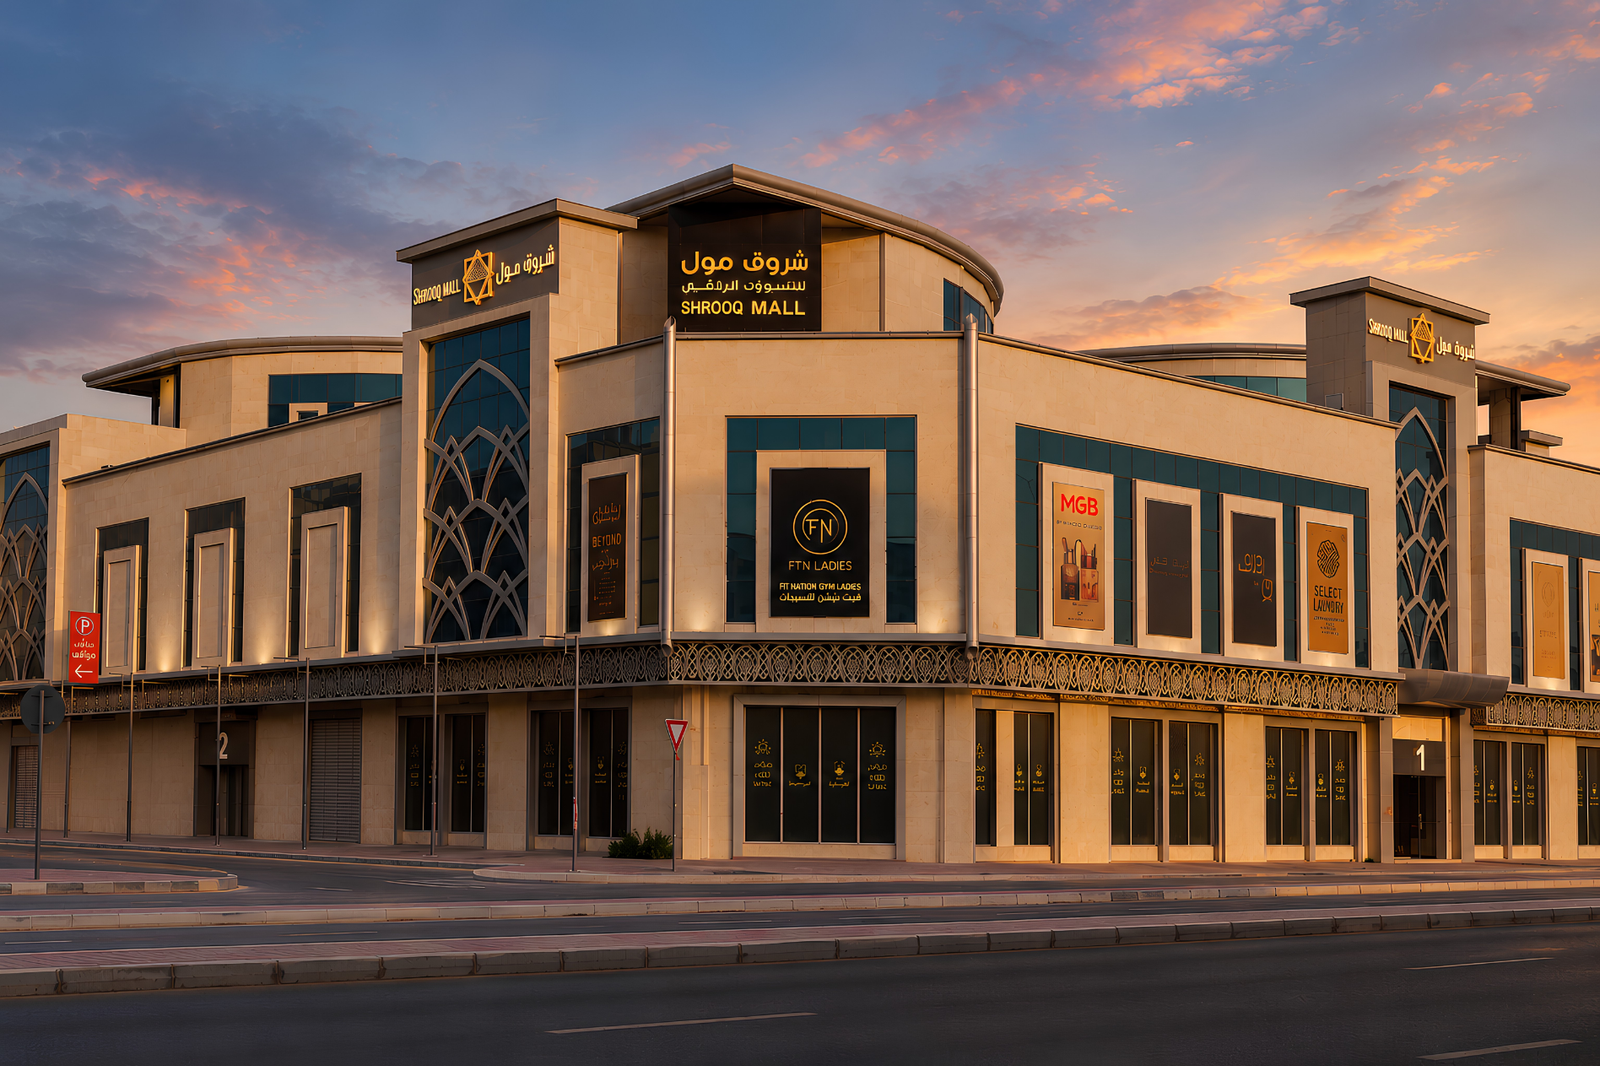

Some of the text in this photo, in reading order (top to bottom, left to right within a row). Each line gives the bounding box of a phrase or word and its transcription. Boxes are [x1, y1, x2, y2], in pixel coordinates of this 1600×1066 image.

[681, 249, 809, 276] شروق مول
[443, 279, 462, 297] MALL
[681, 300, 806, 316] SHROOQ MALL
[1060, 493, 1099, 517] MGB
[788, 560, 853, 571] FTN LADIES
[779, 582, 789, 591] FIT
[1314, 585, 1342, 600] SELECT
[219, 732, 229, 760] 2
[1416, 744, 1425, 771] 1
